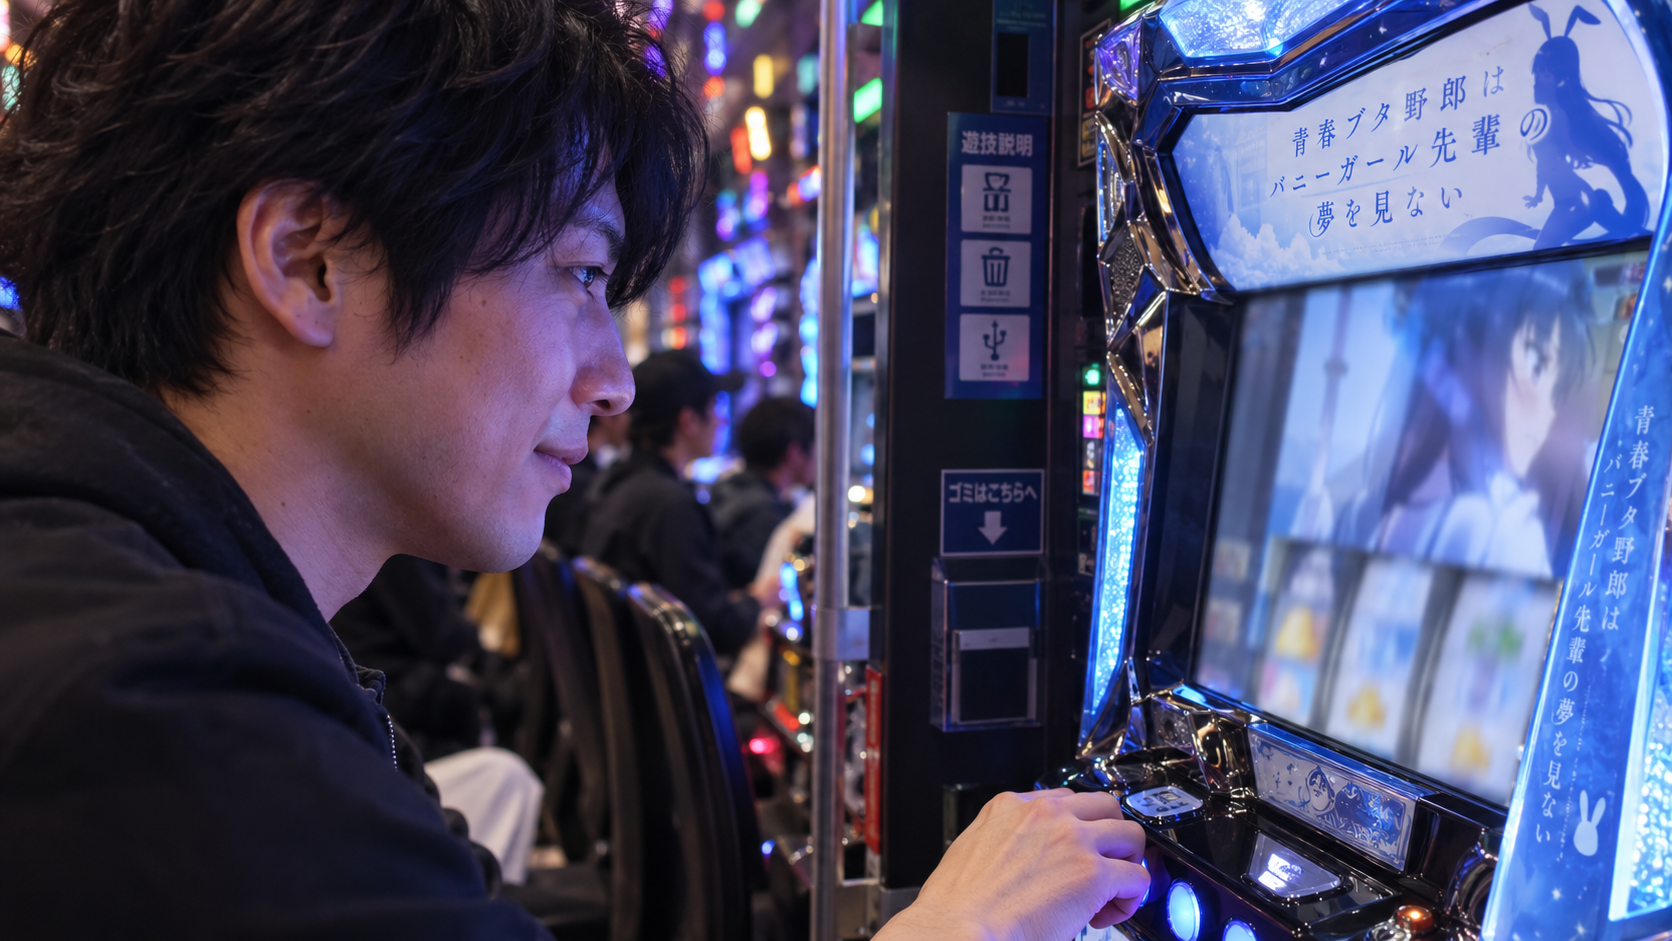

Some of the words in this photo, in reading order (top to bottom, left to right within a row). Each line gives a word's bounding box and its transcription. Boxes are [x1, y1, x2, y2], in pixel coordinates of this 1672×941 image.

[961, 130, 1033, 157] 遊技説明
[1270, 108, 1548, 198] バニーガール先輩の
[1292, 65, 1504, 157] 青春ブタ野郎は
[1309, 186, 1462, 238] 夢を見ない
[949, 482, 1038, 503] ゴミはこちらへ
[1602, 405, 1655, 630] 青春ブタ野郎は
[1536, 454, 1622, 843] バニーガール先輩の夢を見ない
